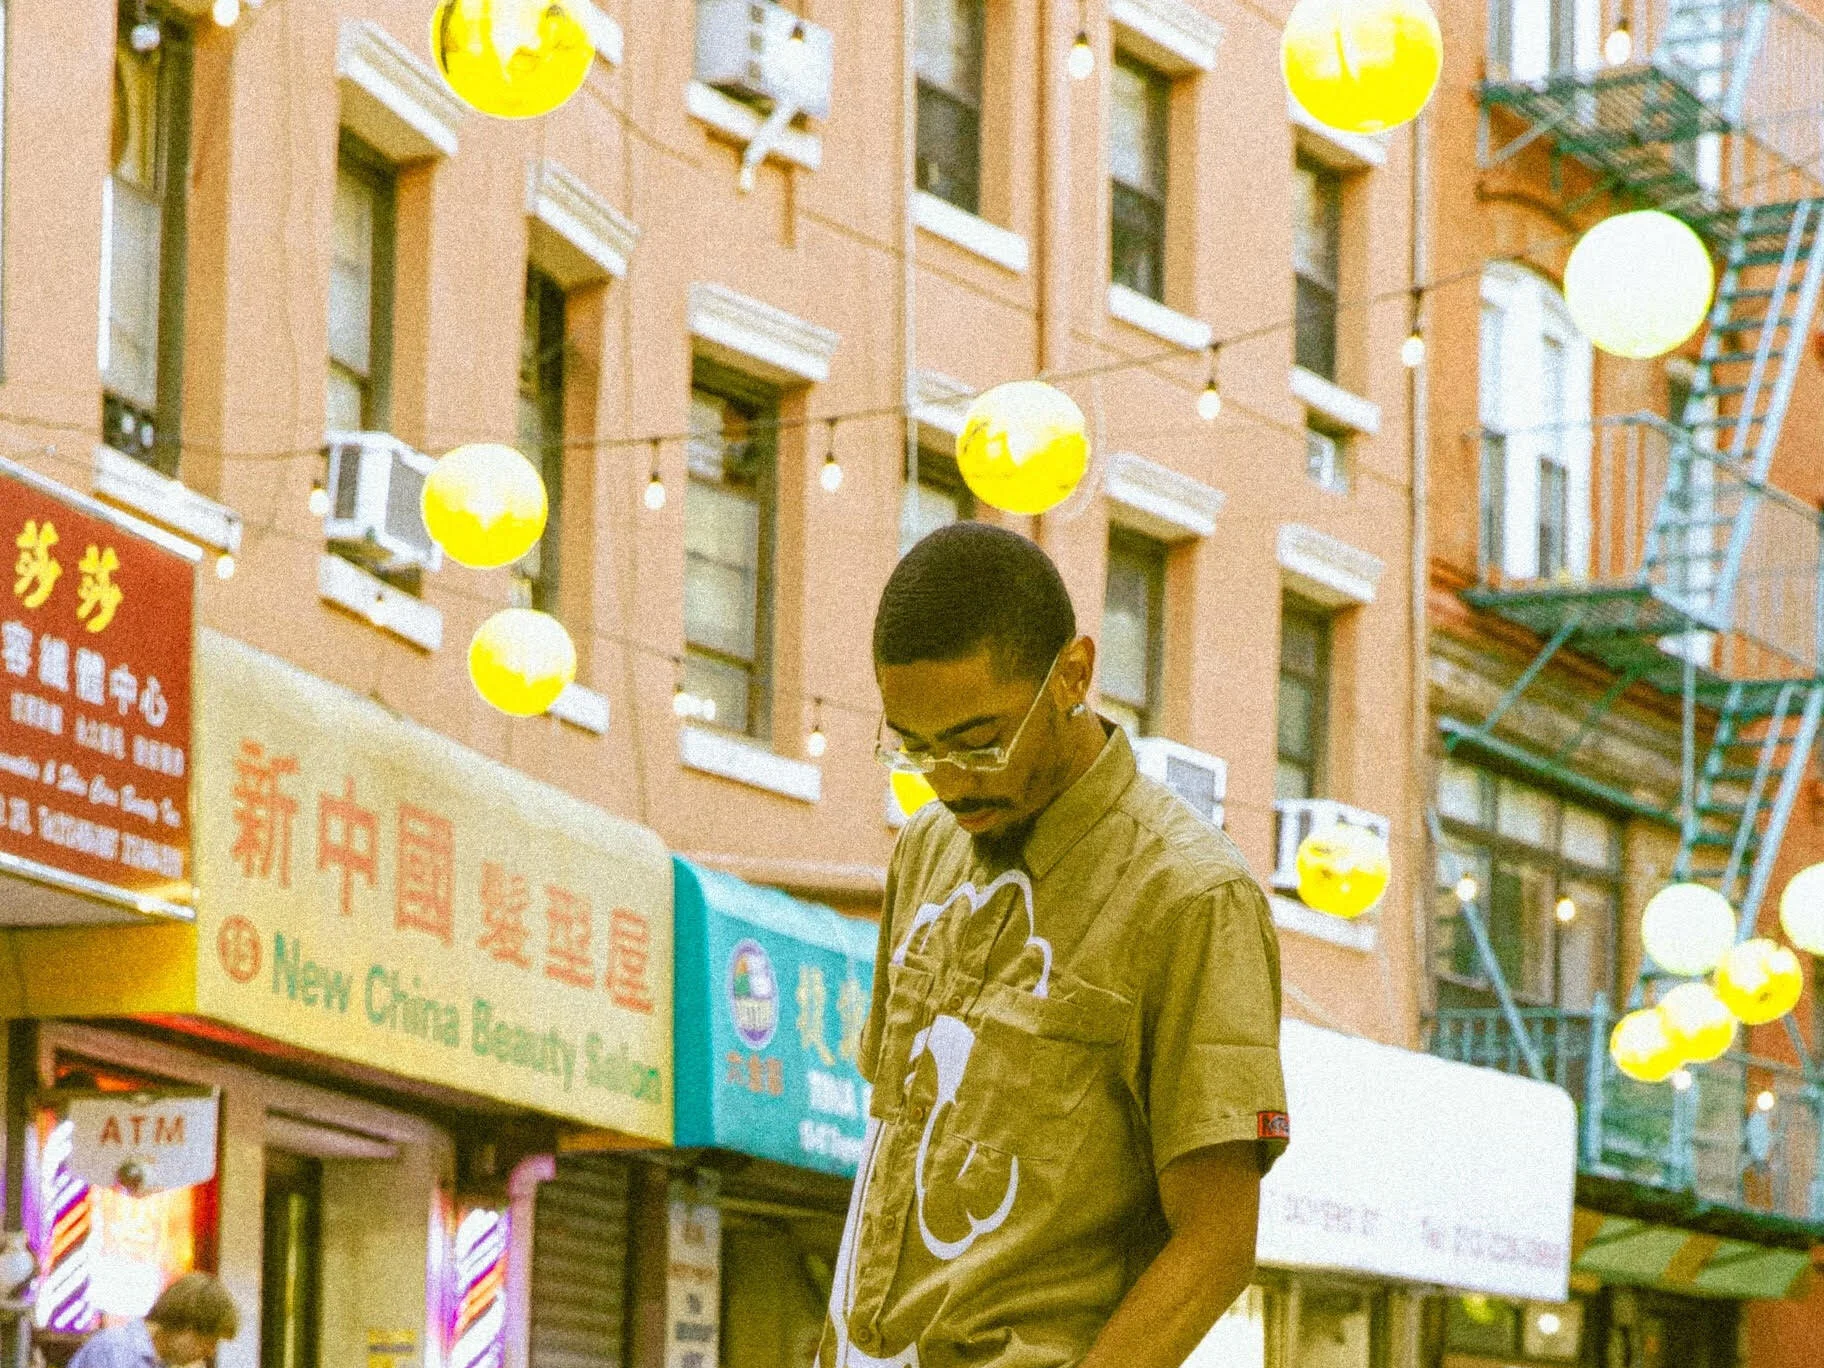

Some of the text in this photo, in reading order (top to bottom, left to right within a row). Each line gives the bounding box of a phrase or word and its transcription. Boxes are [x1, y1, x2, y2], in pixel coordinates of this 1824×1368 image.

[14, 520, 124, 633] 莎莎
[272, 930, 354, 1013] New
[364, 965, 461, 1048] China
[471, 1000, 578, 1091] Beauty
[586, 1031, 663, 1105] Salon
[100, 1115, 186, 1146] ATM
